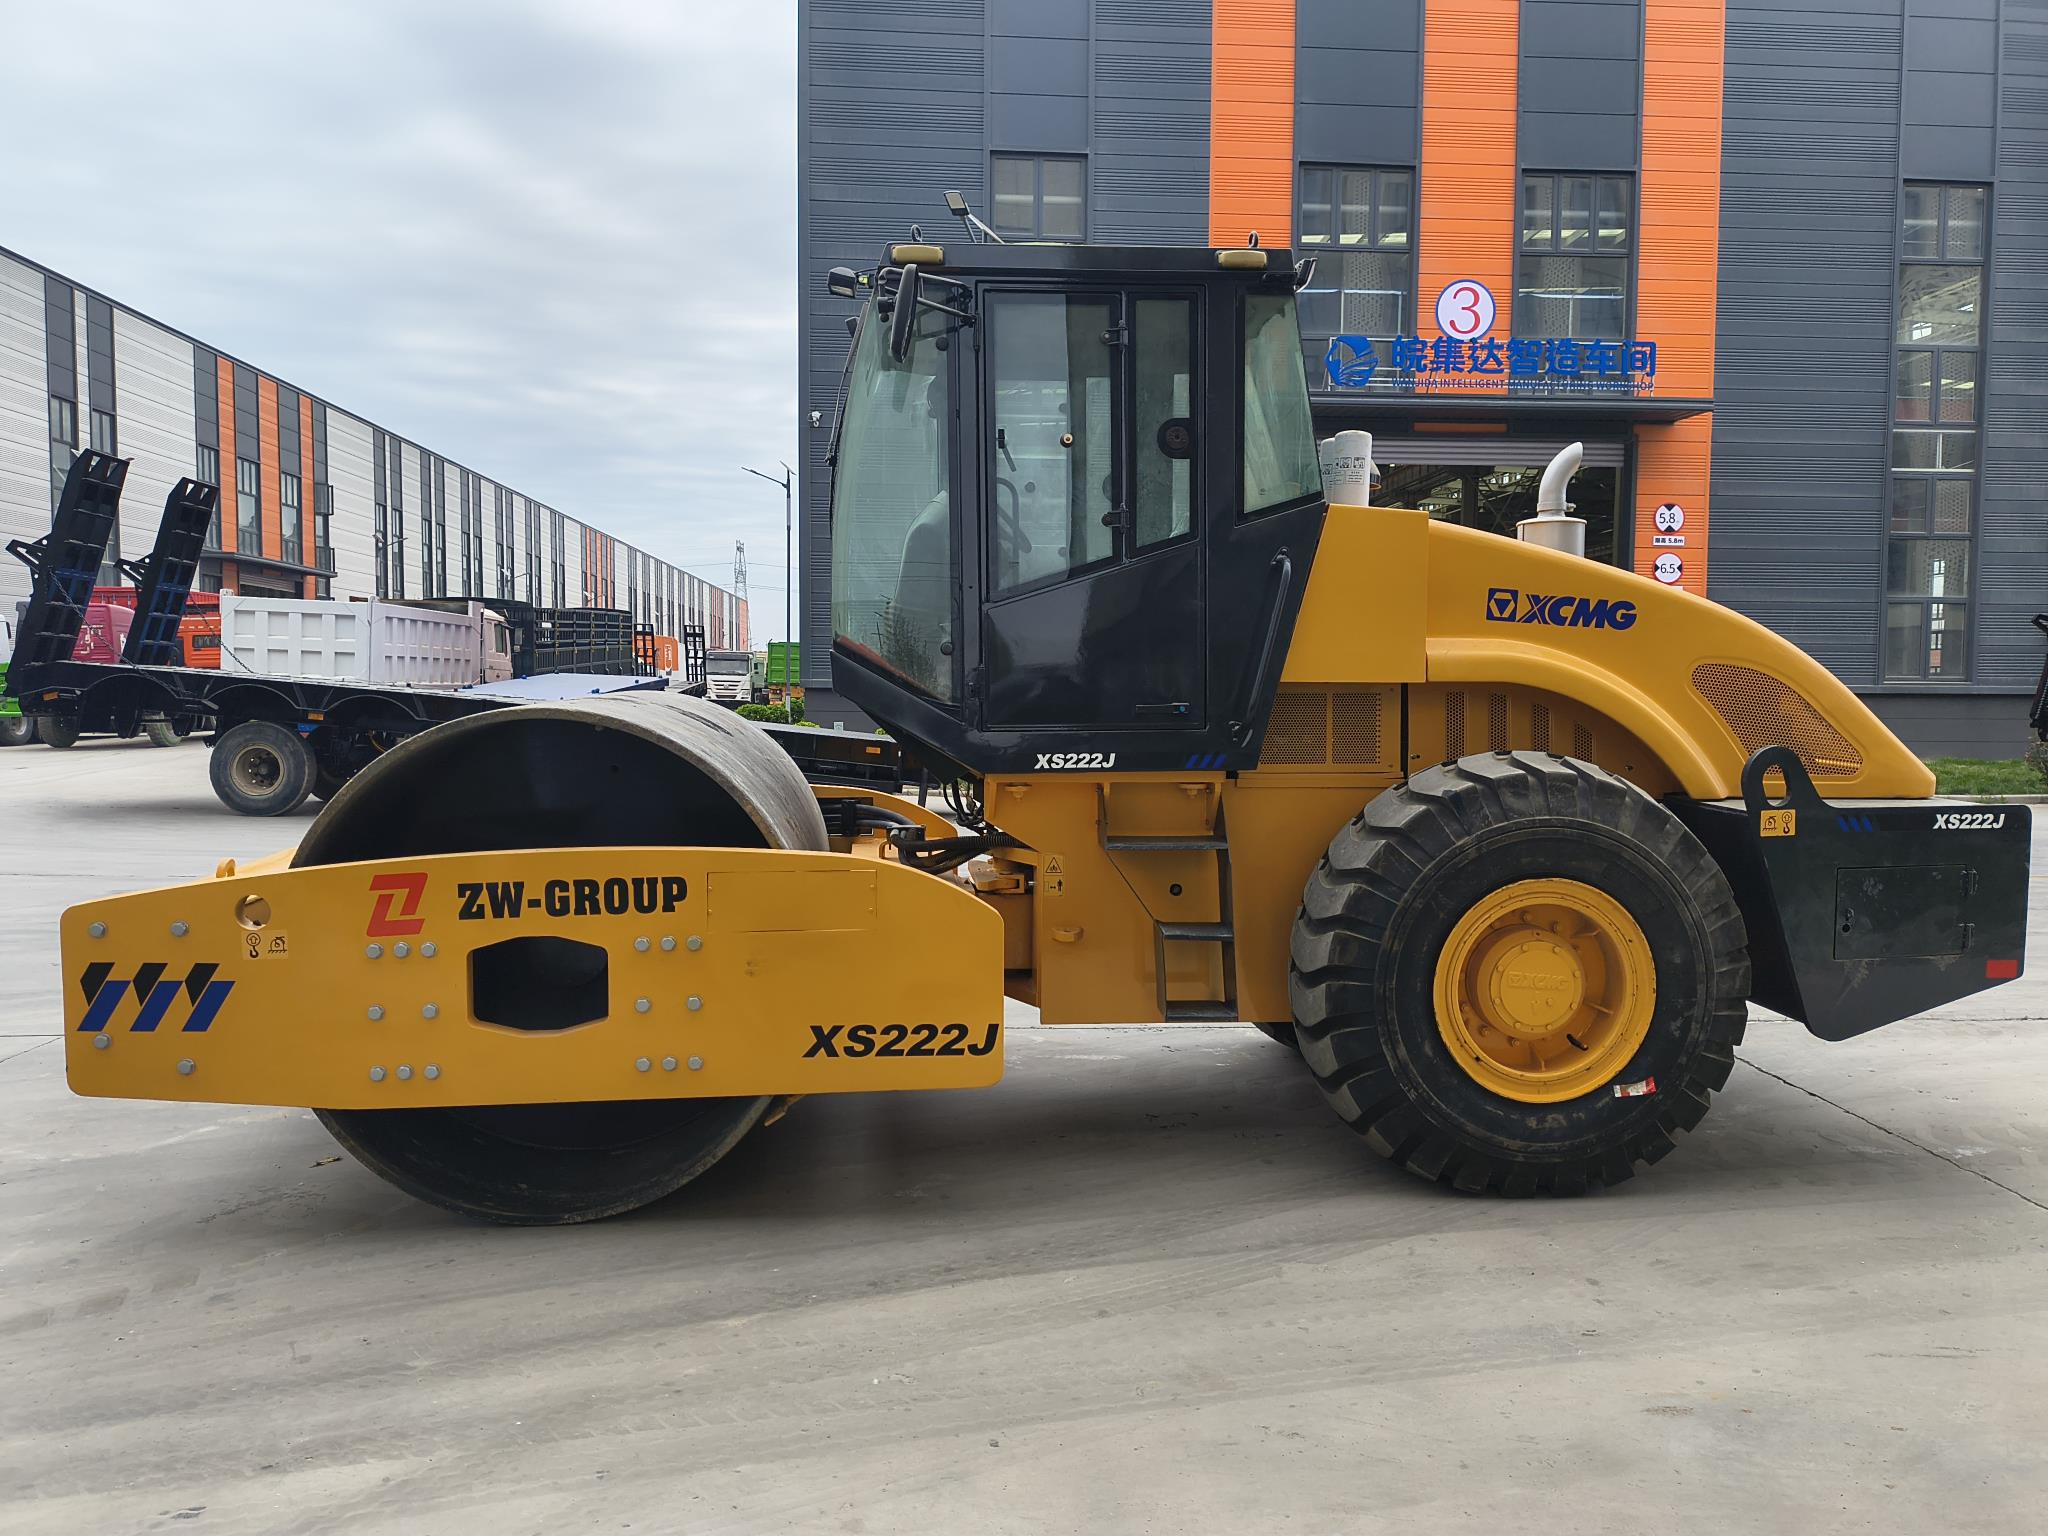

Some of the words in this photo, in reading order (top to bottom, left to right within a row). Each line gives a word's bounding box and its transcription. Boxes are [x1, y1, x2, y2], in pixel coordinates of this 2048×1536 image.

[1449, 286, 1481, 335] 3
[1392, 335, 1656, 377] 皖集达智造车间
[1440, 378, 1506, 389] INTELLIGENT
[1516, 593, 1638, 631] XCMG
[1033, 752, 1116, 770] XS222J
[1932, 813, 2006, 830] XS222J
[457, 876, 688, 921] ZW-GROUP
[801, 1023, 1000, 1058] XS222J
